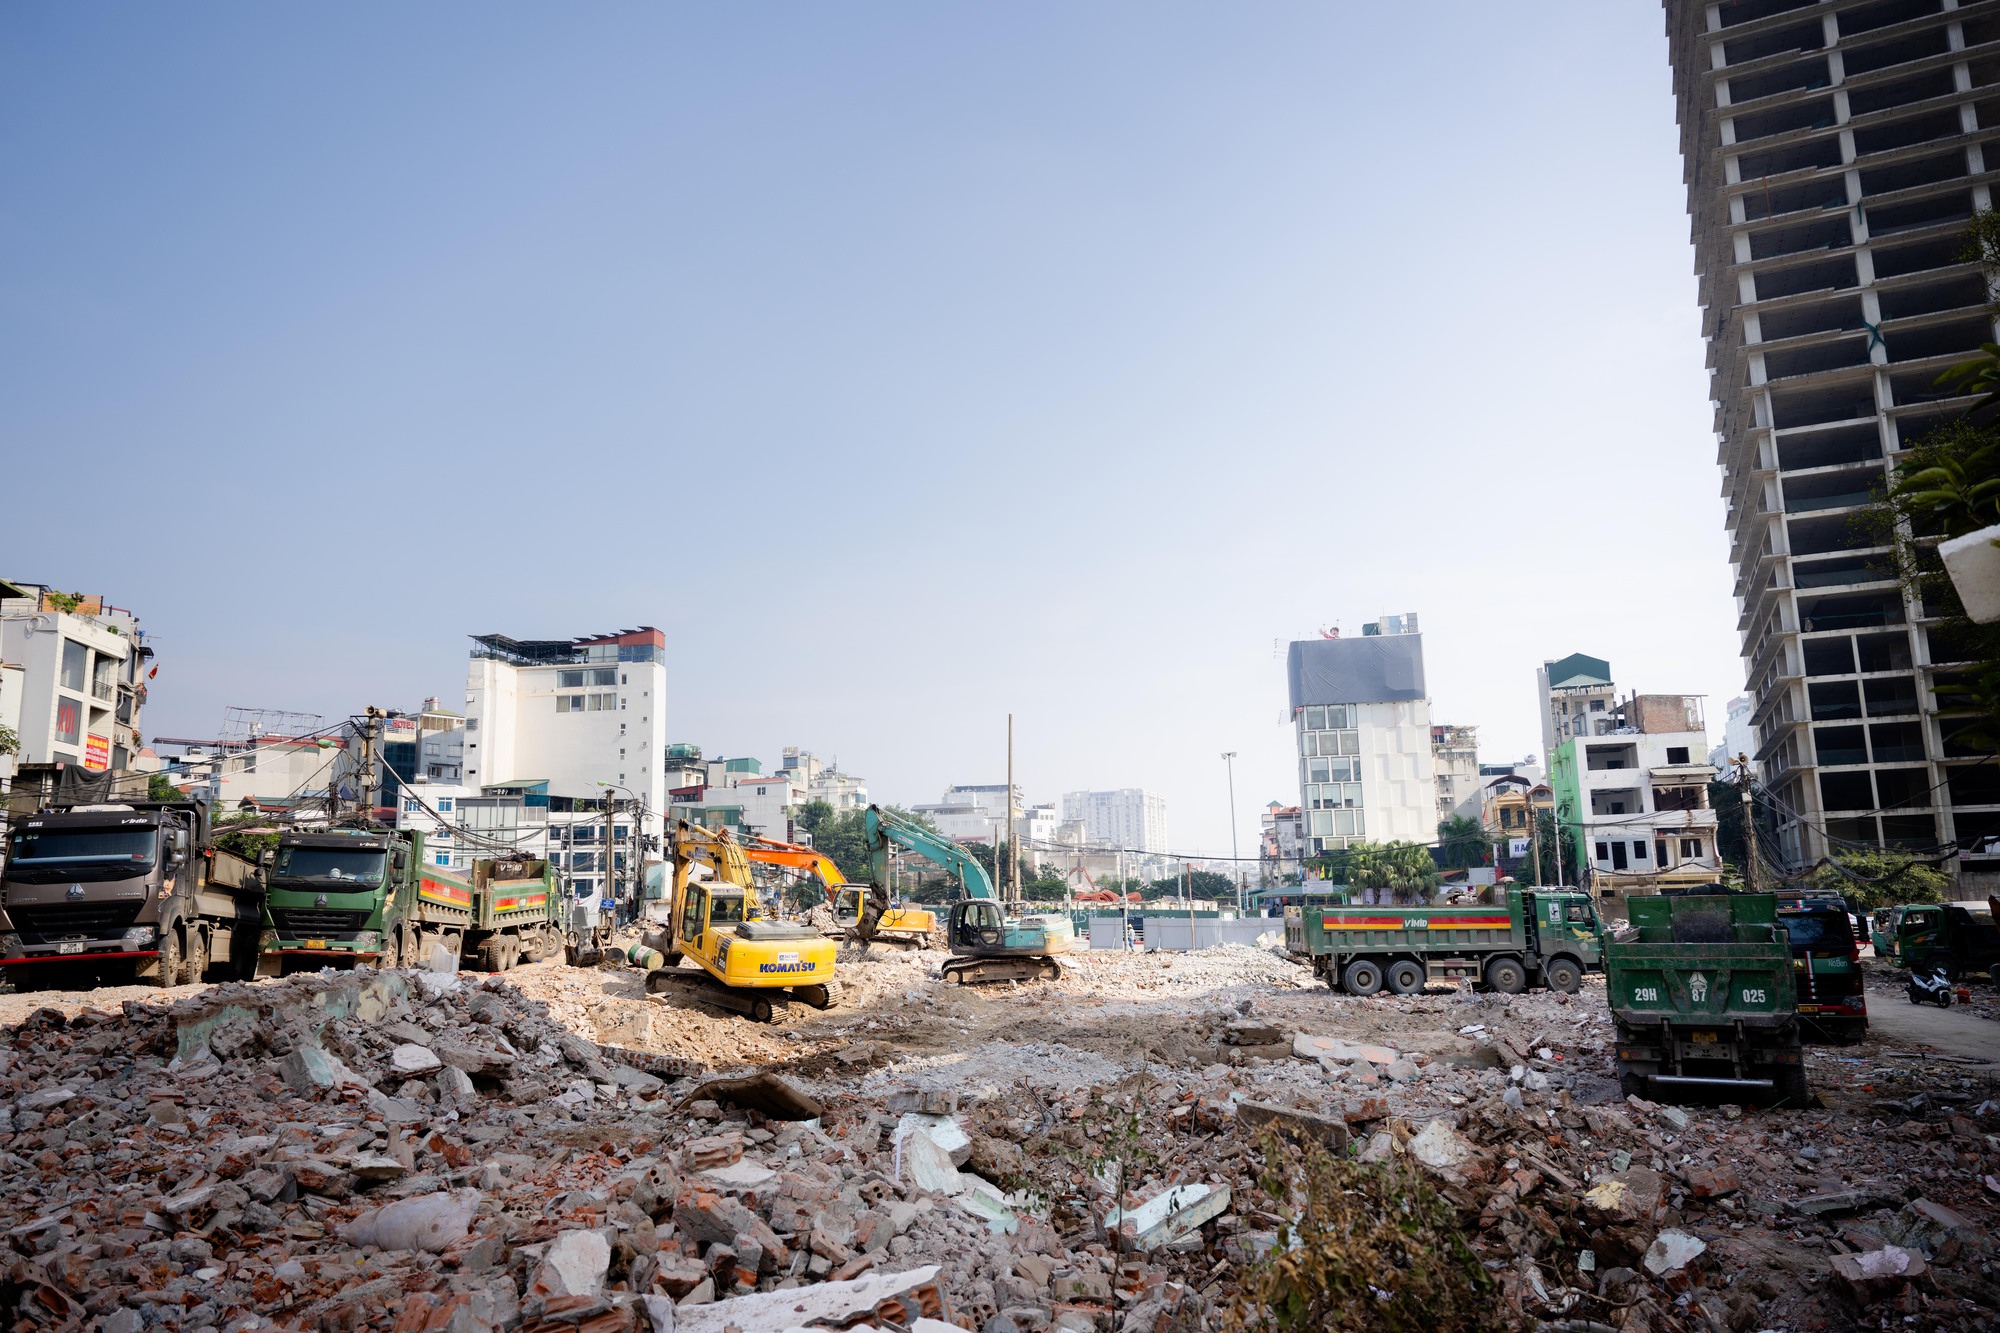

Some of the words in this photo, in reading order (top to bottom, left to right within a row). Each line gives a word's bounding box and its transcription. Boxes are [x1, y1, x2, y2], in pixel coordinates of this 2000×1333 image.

[392, 720, 416, 729] HOTEL
[759, 961, 816, 973] KOMATSU
[1634, 988, 1657, 1001] 29H
[1691, 989, 1706, 1002] 87
[1742, 989, 1766, 1003] 025
